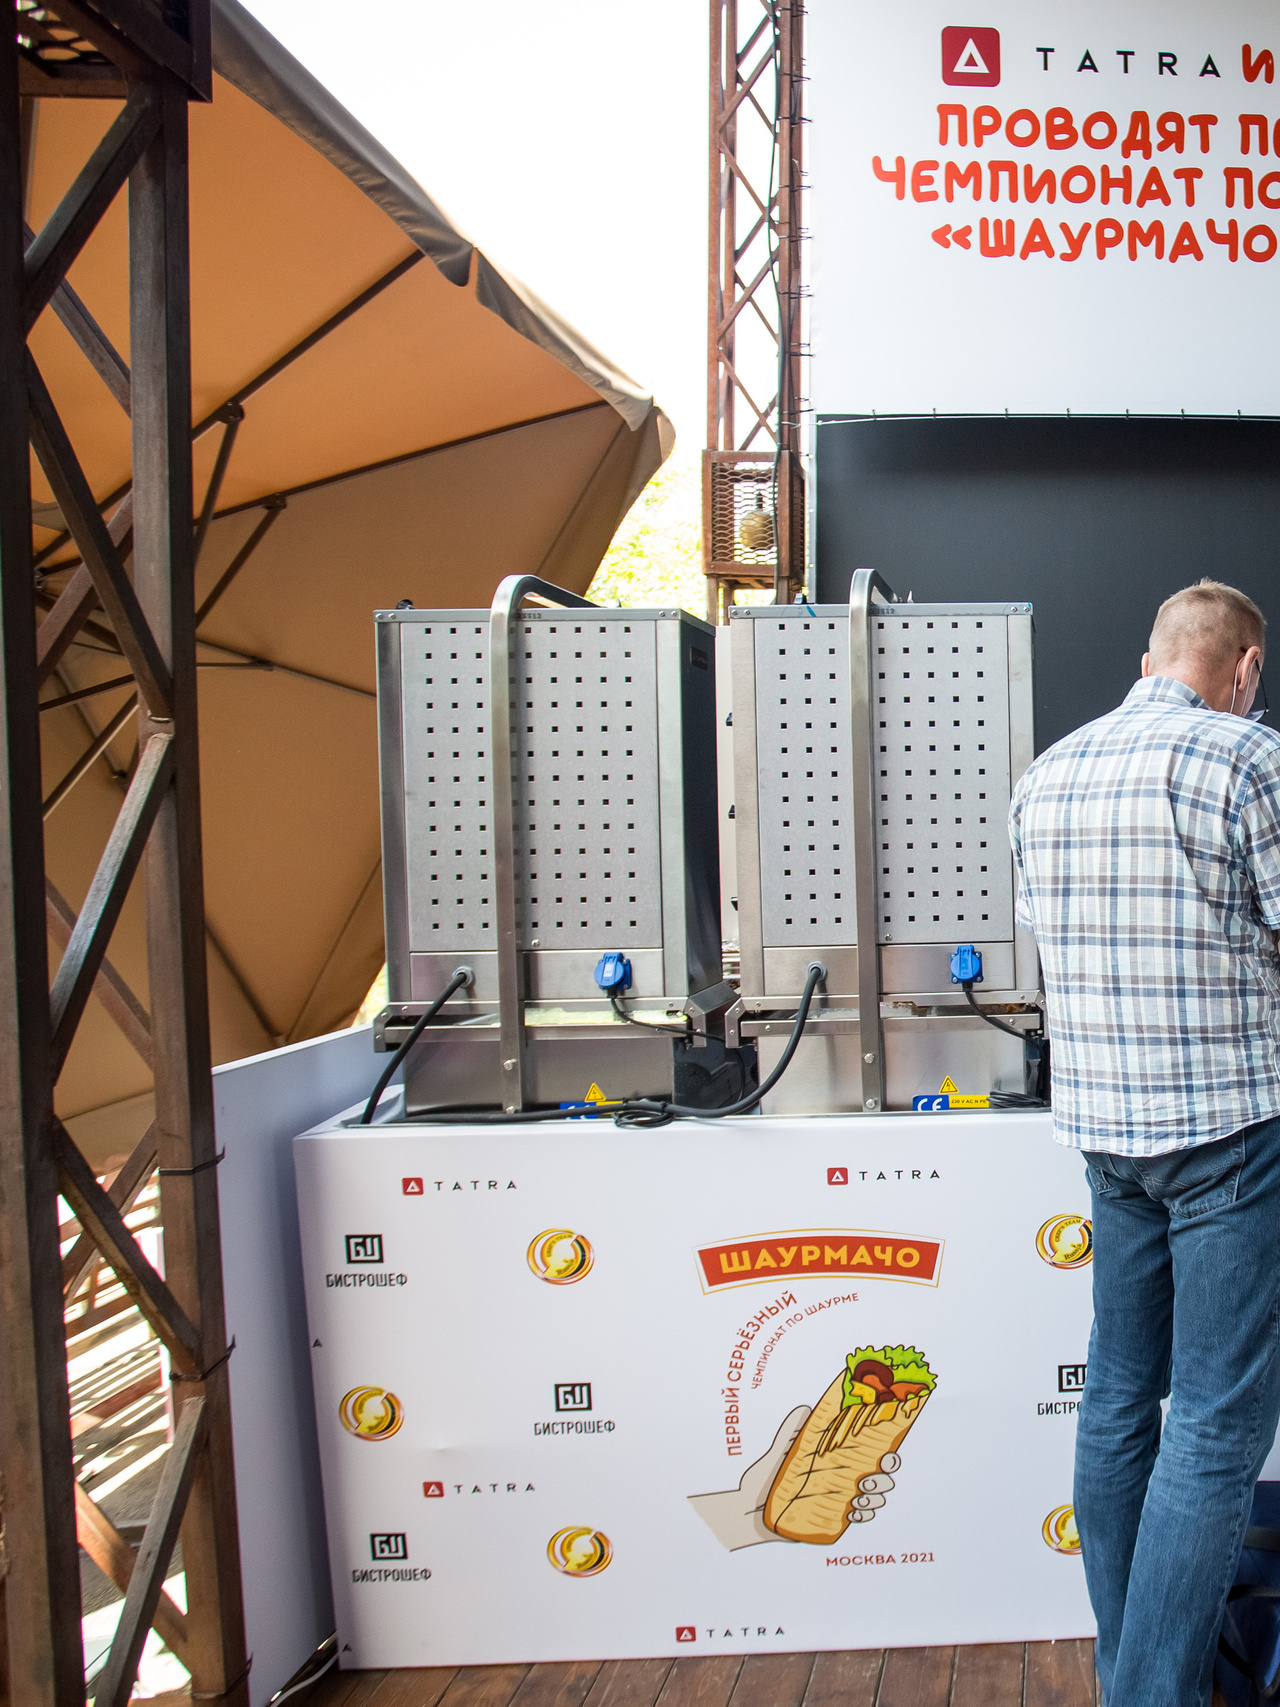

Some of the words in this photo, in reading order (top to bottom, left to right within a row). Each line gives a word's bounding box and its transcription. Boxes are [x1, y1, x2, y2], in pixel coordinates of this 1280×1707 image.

[1036, 47, 1221, 78] TATRA
[1241, 43, 1275, 84] И
[936, 103, 1217, 160] ПРОВОДЯТ
[872, 155, 1206, 210] ЧЕМПИОНАТ
[434, 1179, 518, 1191] TATRA
[858, 1169, 941, 1181] TATRA
[719, 1244, 921, 1275] ШАУРМАЧО
[326, 1272, 408, 1288] БИСТРОШЕФ
[727, 1290, 798, 1382] СЕРЬЁЗНЫЙ
[751, 1325, 787, 1390] ЧЕМПИОНАТ
[785, 1313, 804, 1328] ПО
[804, 1292, 860, 1317] ШАУРМЕ
[534, 1419, 616, 1436] БИСТРОШЕФ
[721, 1387, 743, 1457] ПЕРВЫЙ
[453, 1482, 536, 1494] TATRA
[826, 1554, 896, 1567] МОСКВА
[900, 1552, 935, 1564] 2021
[352, 1568, 432, 1584] БИСТРОШЕФ
[706, 1625, 786, 1639] TATRA
